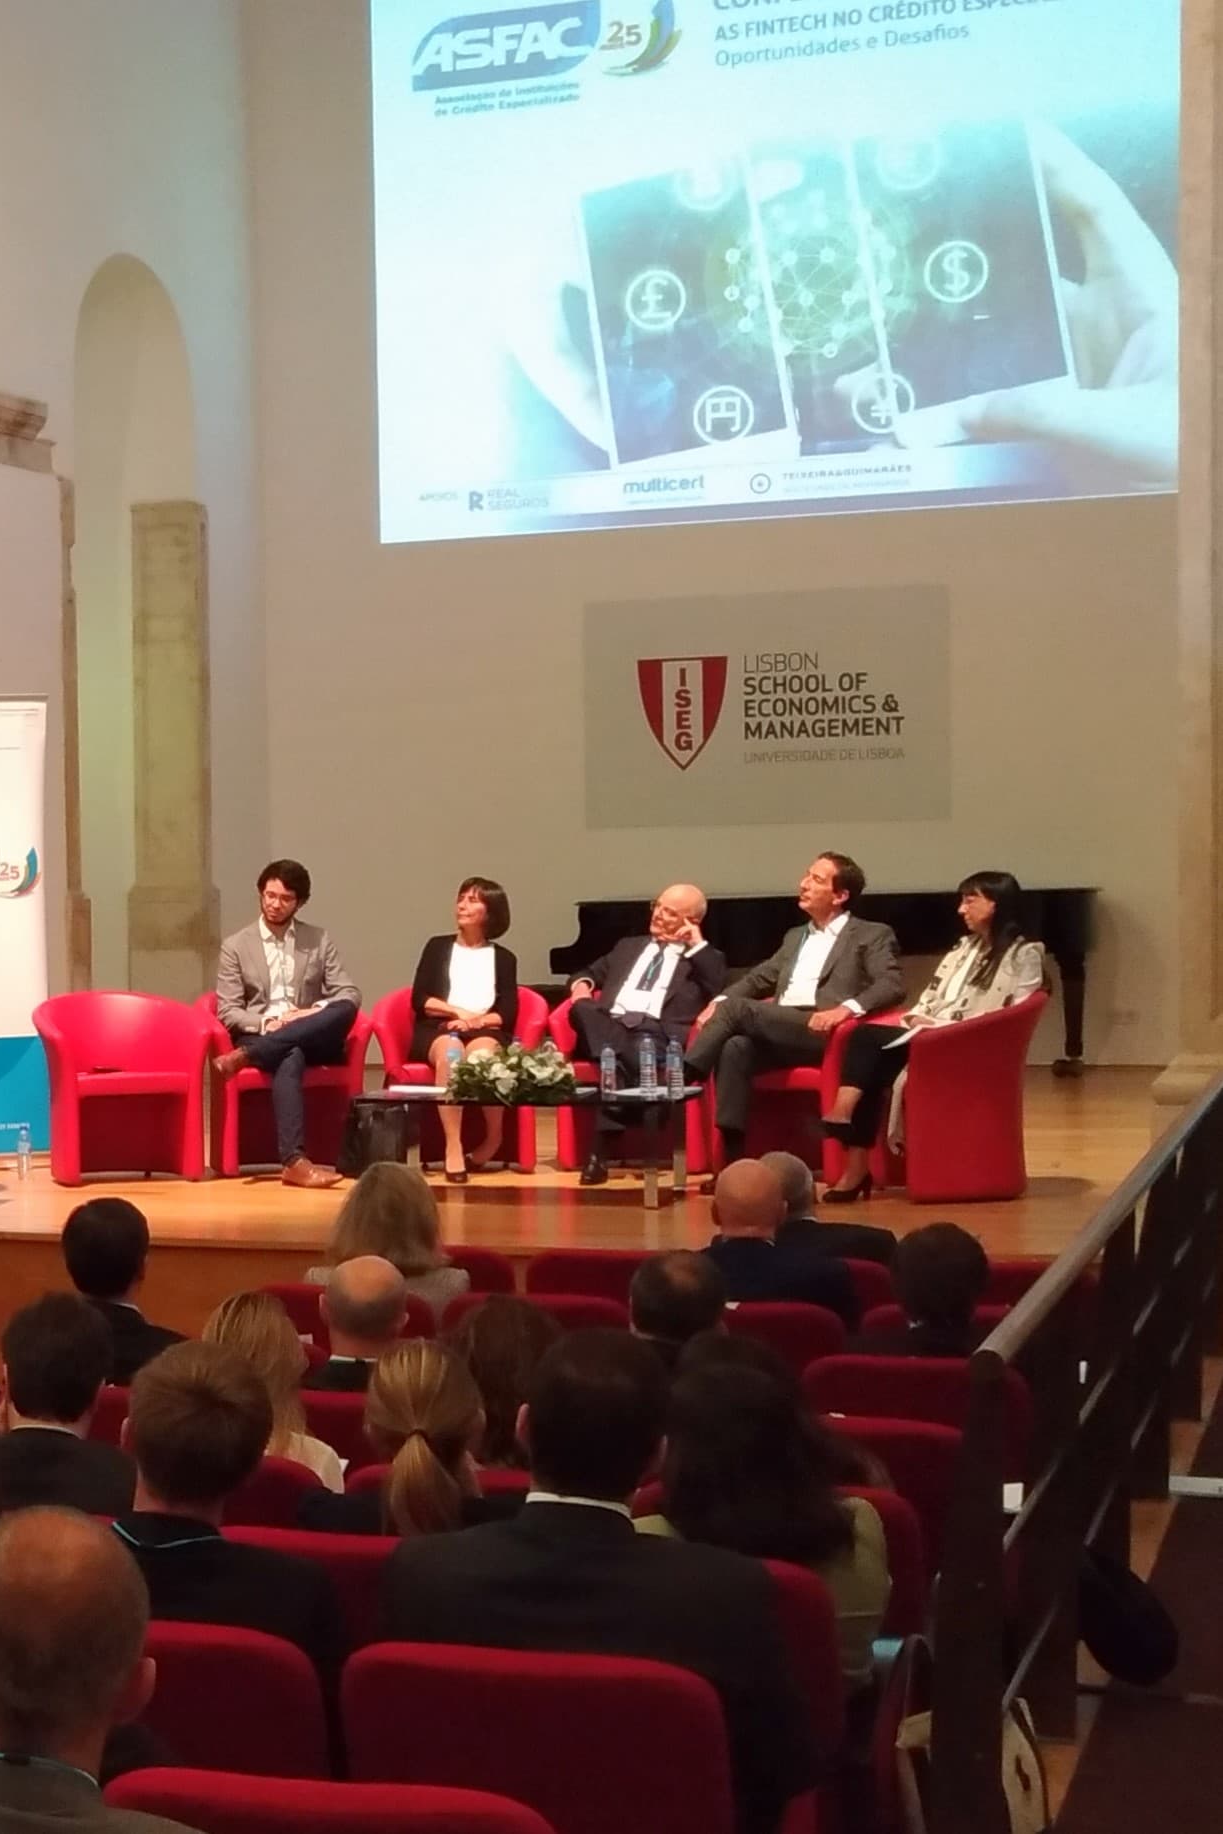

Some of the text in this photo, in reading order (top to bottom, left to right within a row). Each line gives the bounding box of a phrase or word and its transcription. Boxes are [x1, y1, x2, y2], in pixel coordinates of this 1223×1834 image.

[606, 21, 643, 47] 25
[714, 24, 740, 41] AS
[745, 13, 828, 38] FINTECH
[833, 9, 863, 27] NO
[412, 17, 596, 75] ASFAC
[715, 24, 970, 69] Oportunidades e Desafios
[743, 651, 818, 673] LISBON
[743, 672, 868, 696] SCHOOL OF
[674, 667, 693, 751] ISEG
[744, 693, 899, 718] ECONOMICS &
[744, 716, 905, 740] MANAGEMENT
[743, 746, 905, 764] UNIVERSIDADE DE LISBOA
[0, 861, 20, 880] 25
